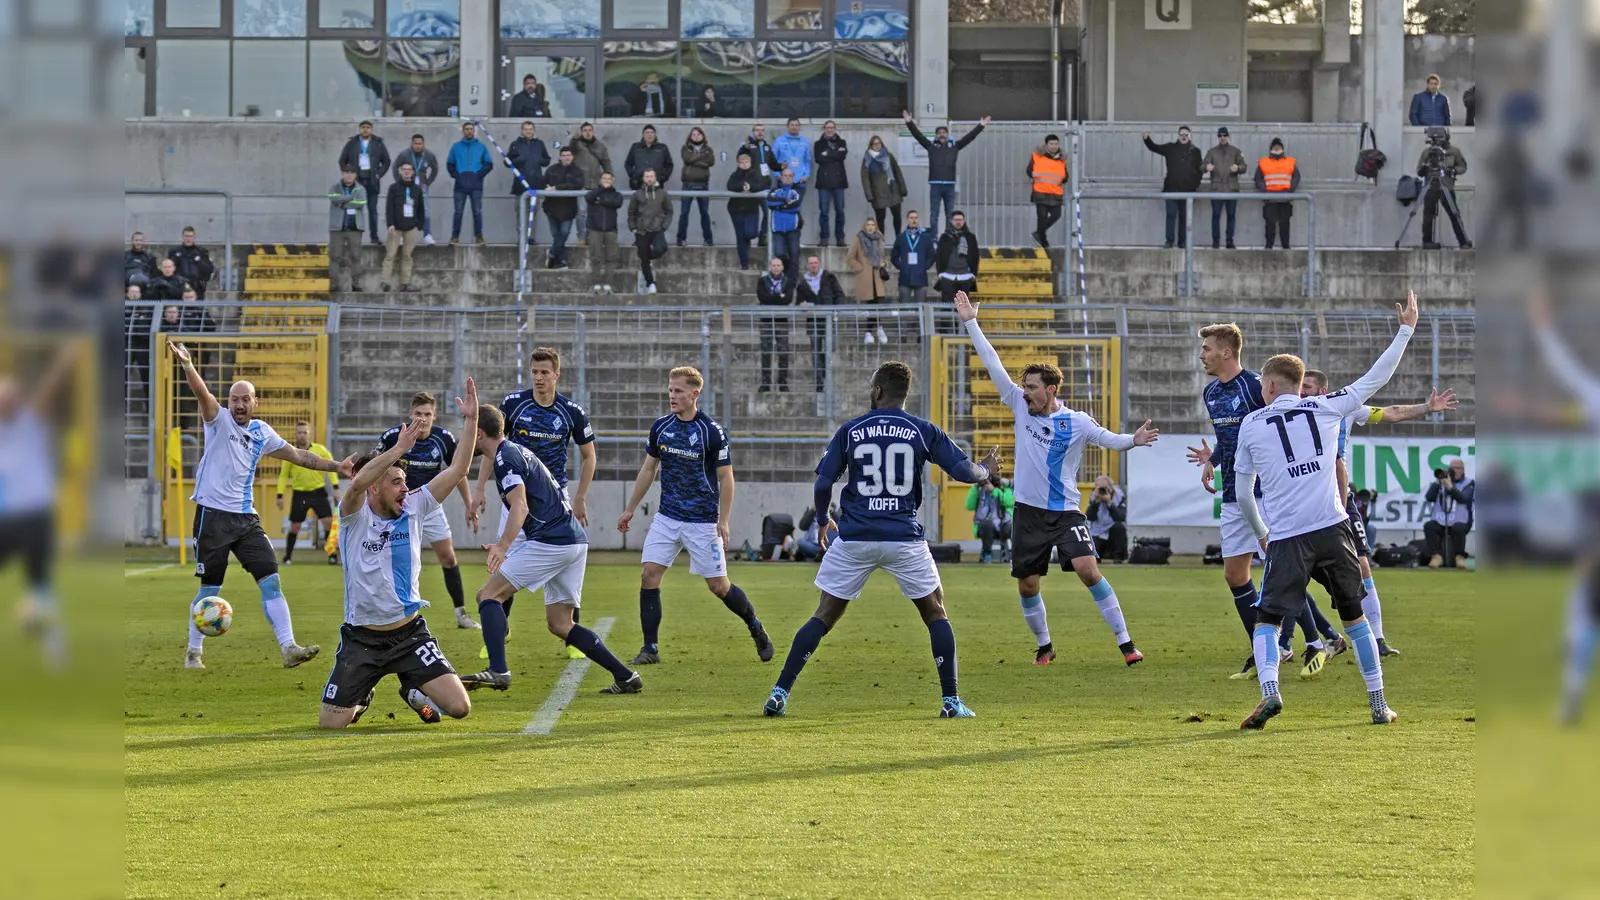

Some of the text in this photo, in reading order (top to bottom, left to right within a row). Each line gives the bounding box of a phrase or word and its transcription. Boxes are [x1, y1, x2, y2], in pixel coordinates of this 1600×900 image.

[1156, 0, 1180, 23] Q
[529, 431, 562, 440] sunmaker
[851, 425, 917, 442] SV WALDHOF
[1266, 410, 1323, 463] 17
[668, 447, 699, 459] sunmaker
[854, 442, 916, 497] 30
[1287, 461, 1321, 478] WEIN
[868, 498, 899, 511] KOFFI
[1070, 525, 1091, 542] 13
[711, 543, 721, 561] 5
[414, 641, 445, 667] 22
